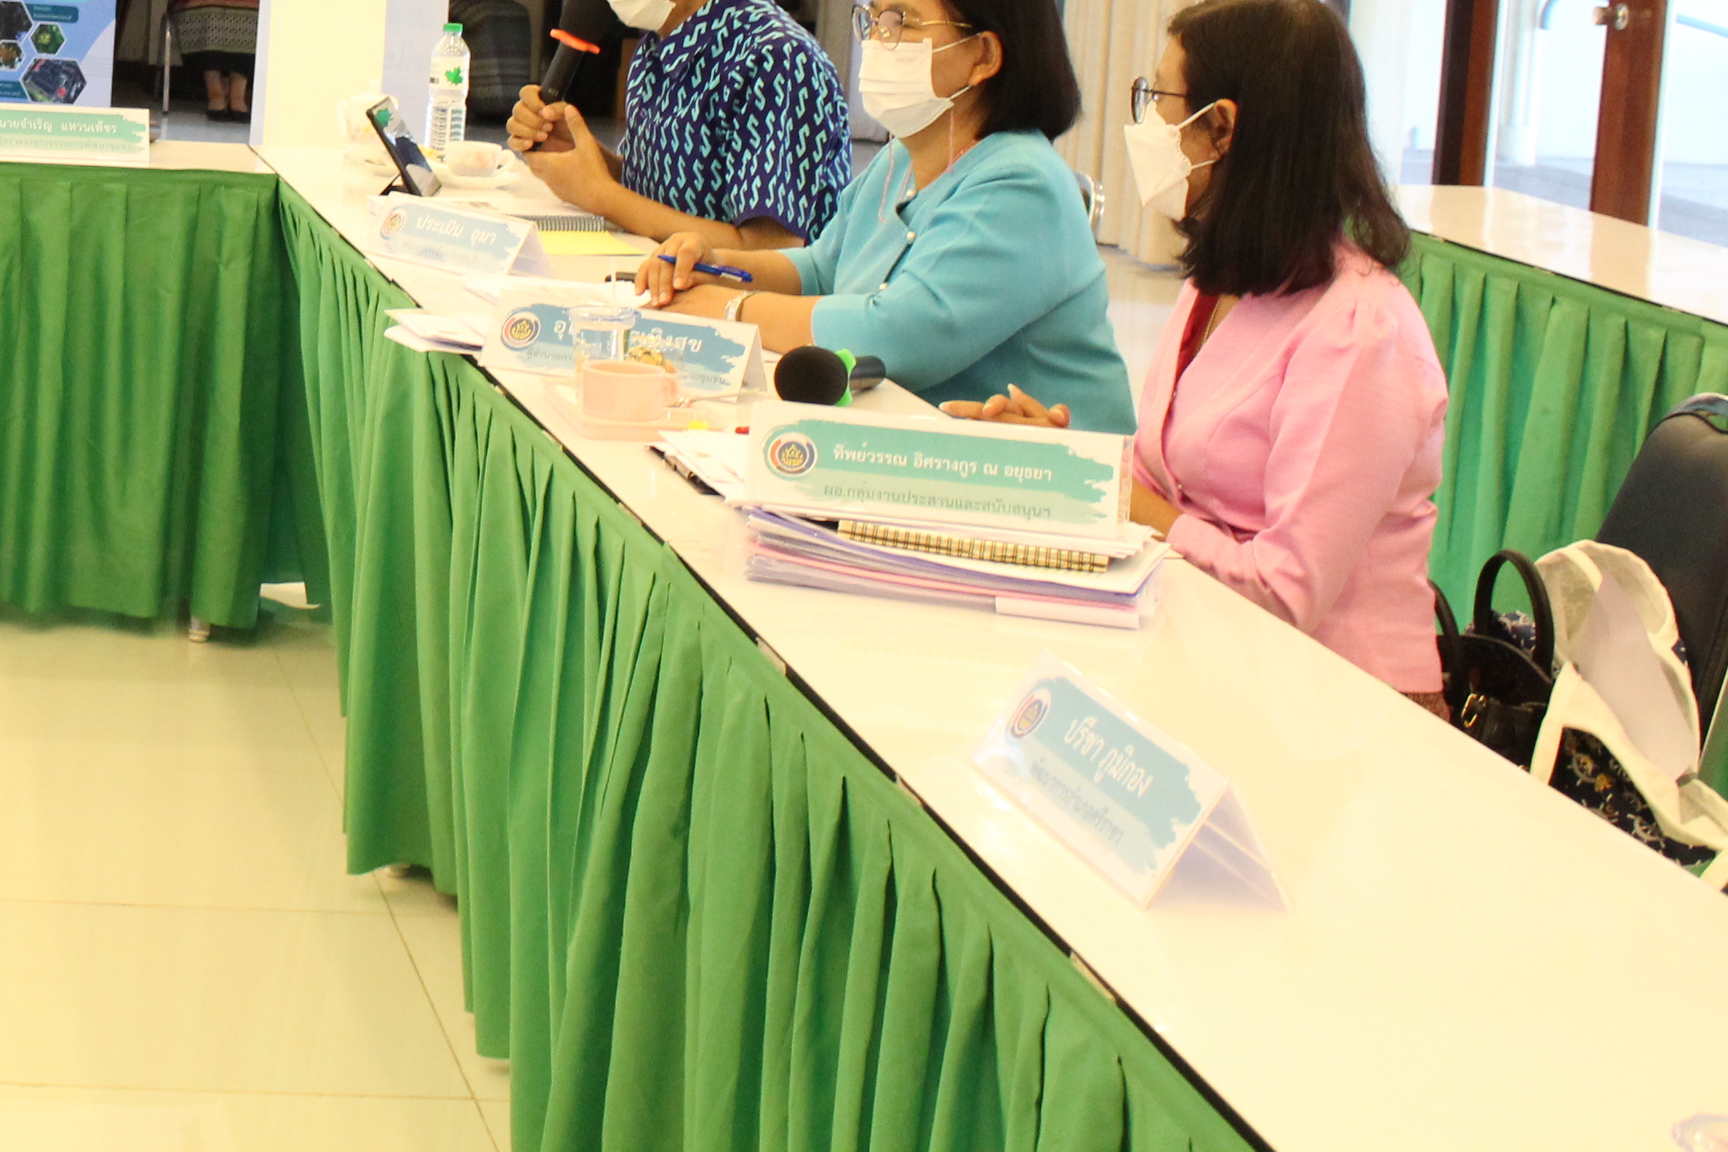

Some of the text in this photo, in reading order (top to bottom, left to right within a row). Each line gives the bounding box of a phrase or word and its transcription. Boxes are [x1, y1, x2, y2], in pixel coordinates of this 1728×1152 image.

[0, 117, 53, 133] นายจำเริญ
[833, 442, 1052, 484] ทิพย์วรรณ อิศรางกูร ณ อยุธยา
[1064, 715, 1105, 762] ปรีชา
